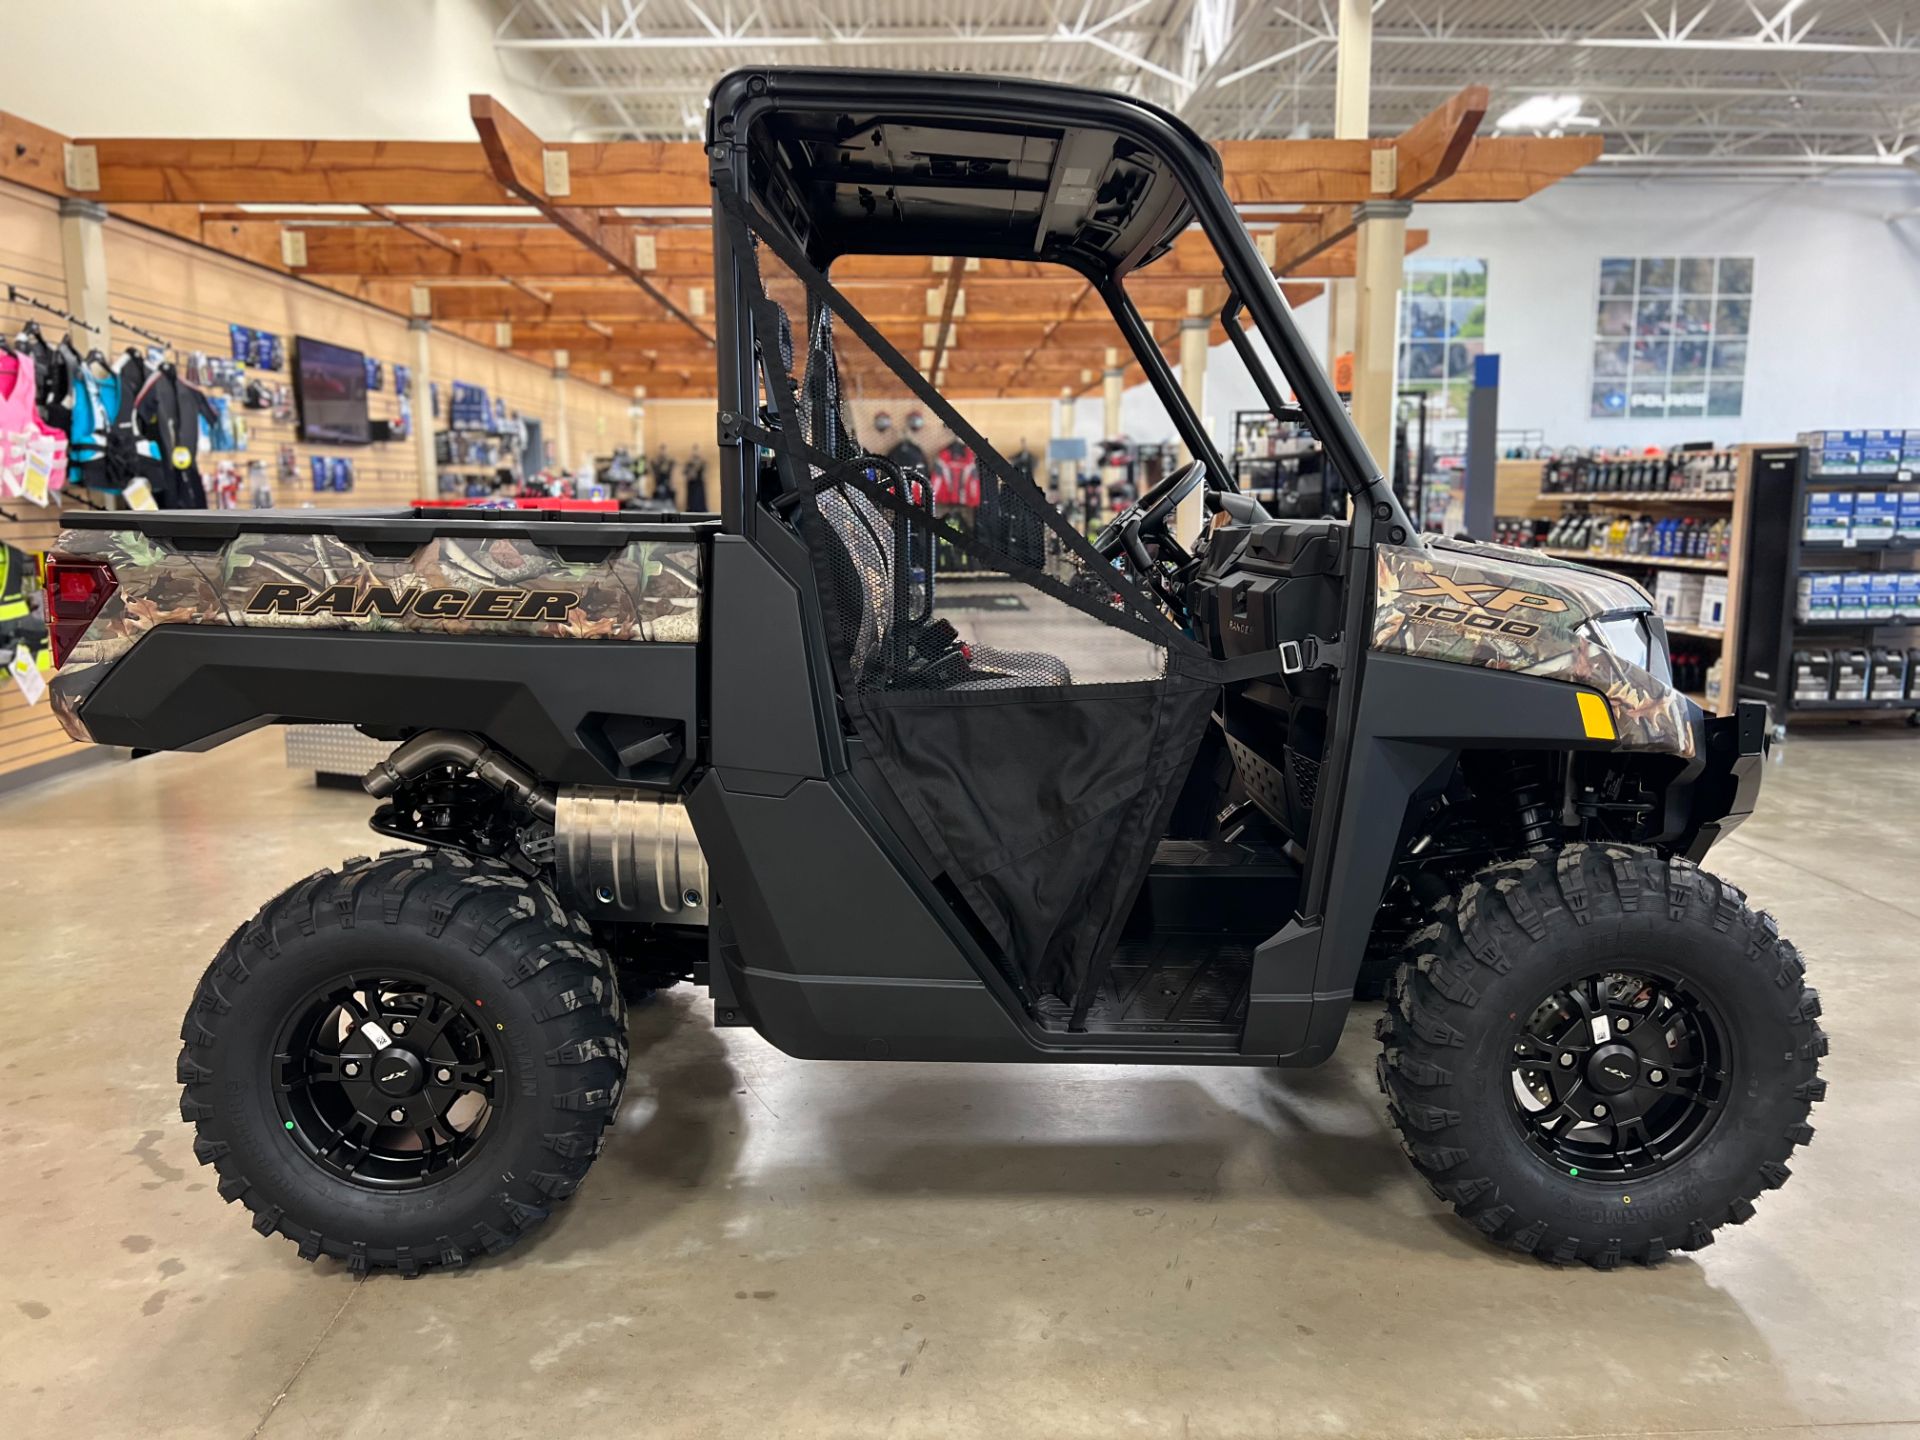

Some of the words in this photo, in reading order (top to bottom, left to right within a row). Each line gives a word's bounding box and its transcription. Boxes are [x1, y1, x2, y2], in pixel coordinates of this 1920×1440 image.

[246, 582, 580, 621] RANGER
[1400, 572, 1569, 613] XP
[1410, 603, 1541, 638] 1000
